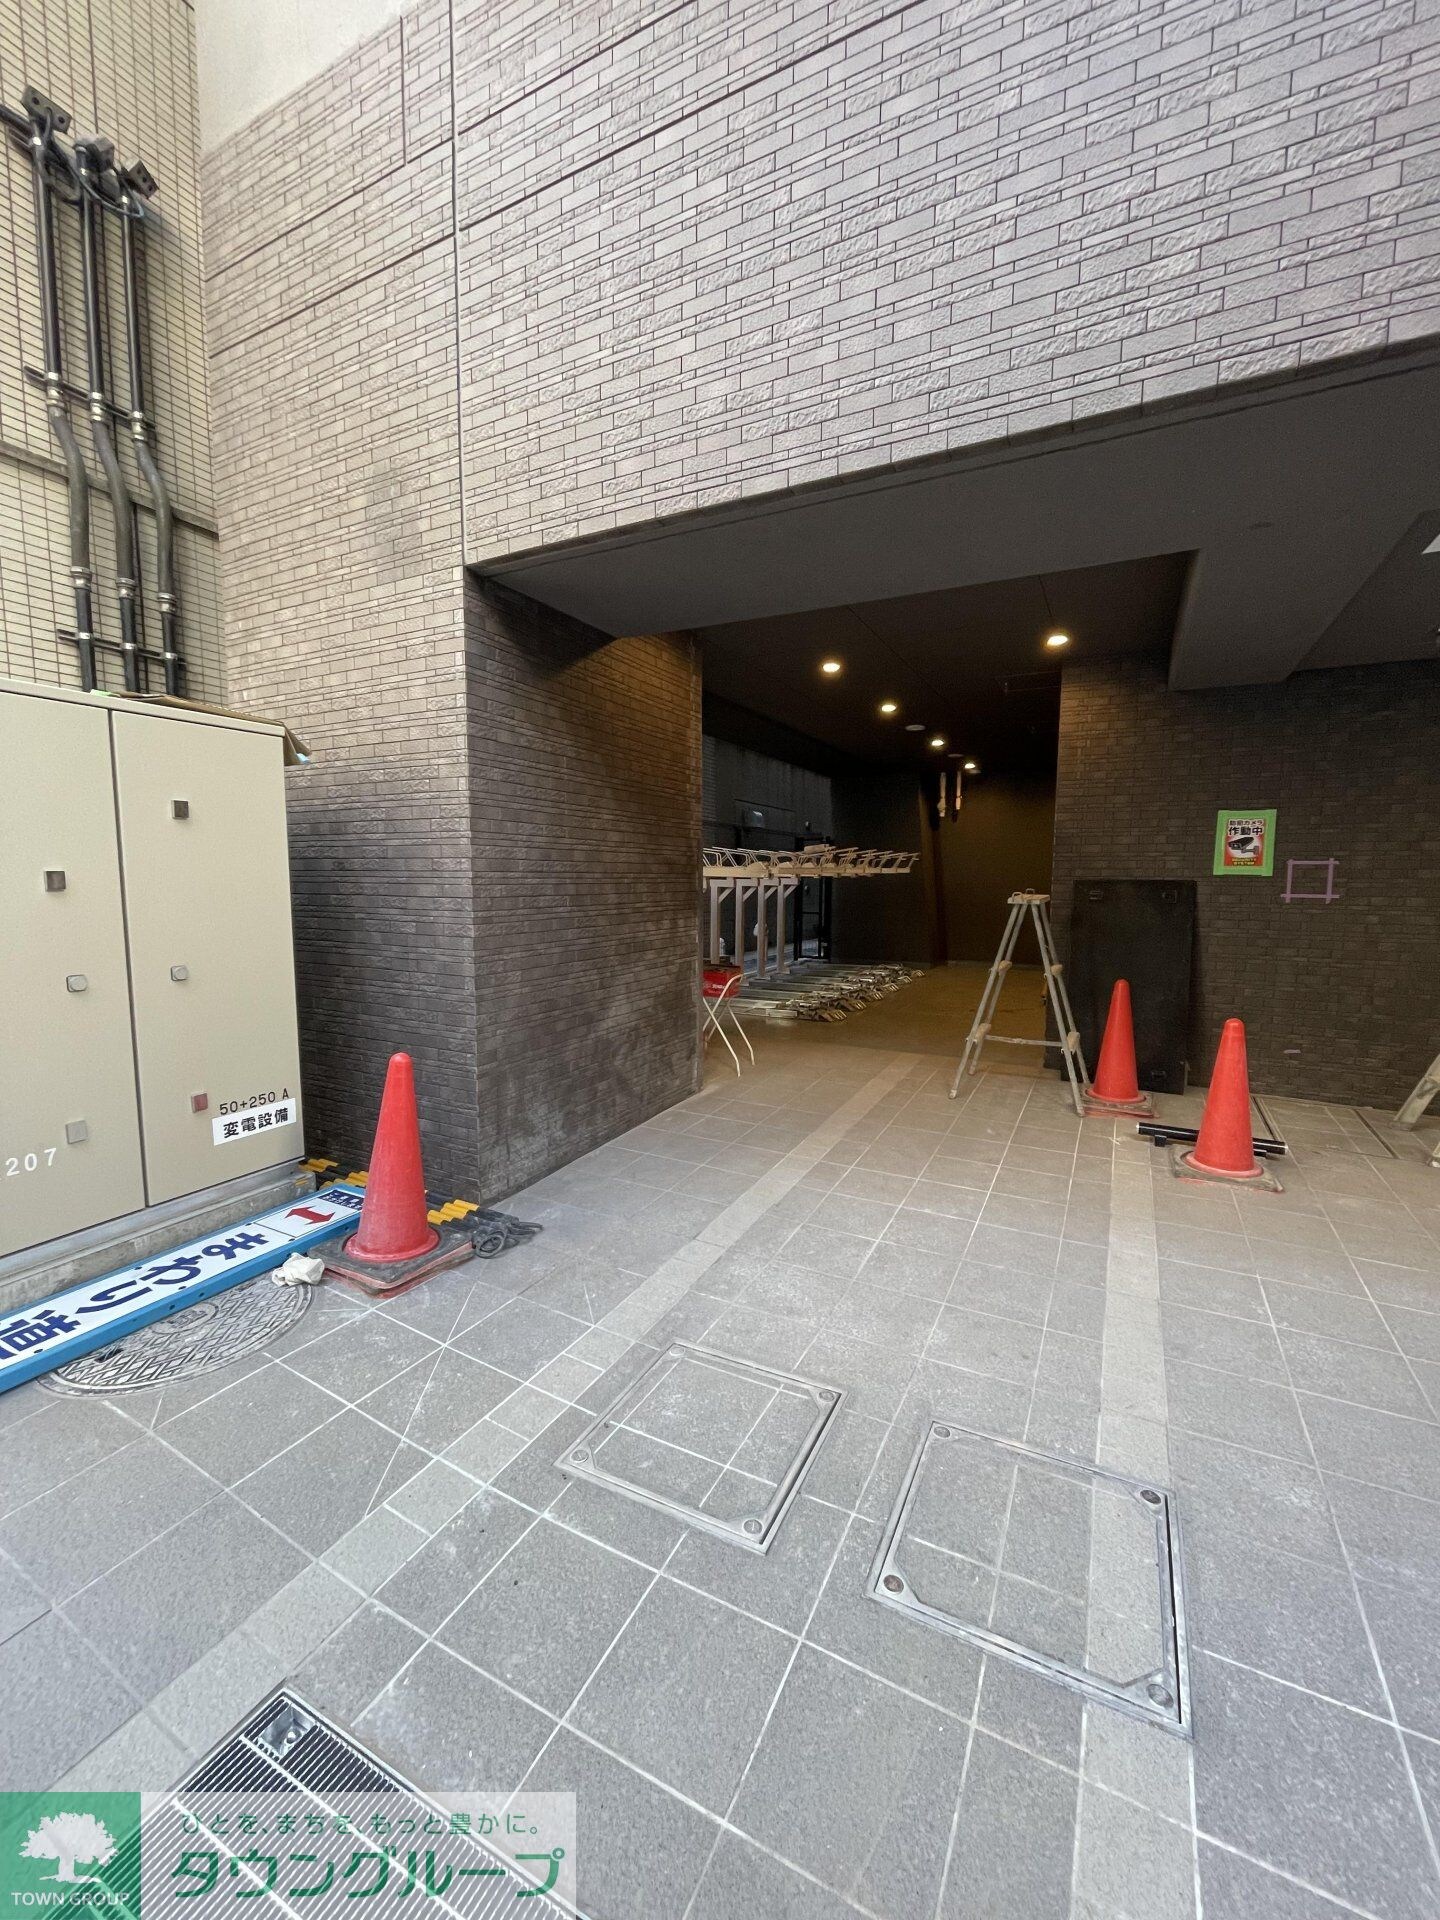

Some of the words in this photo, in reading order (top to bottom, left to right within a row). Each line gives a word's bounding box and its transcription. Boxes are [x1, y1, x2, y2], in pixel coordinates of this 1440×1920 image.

[1228, 826, 1263, 835] 作動中
[220, 1091, 276, 1115] 50+250
[282, 1087, 290, 1100] A
[223, 1107, 289, 1138] 変電設備
